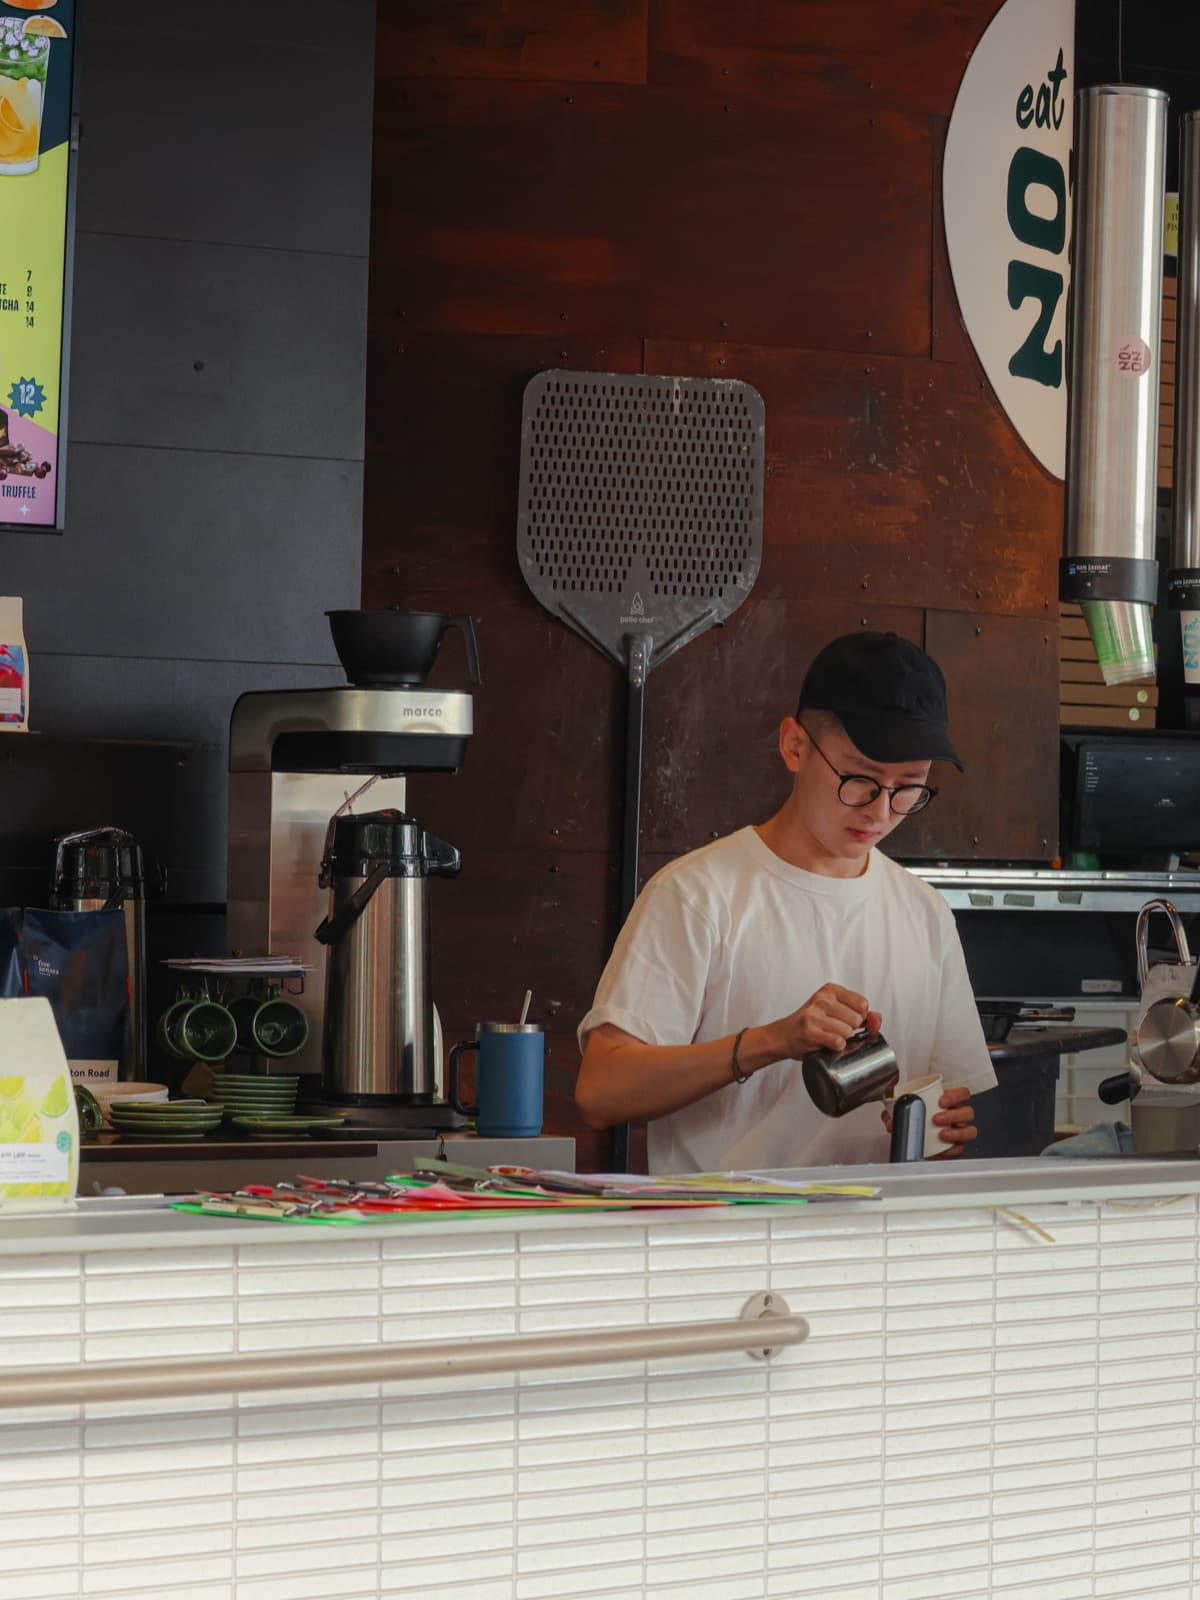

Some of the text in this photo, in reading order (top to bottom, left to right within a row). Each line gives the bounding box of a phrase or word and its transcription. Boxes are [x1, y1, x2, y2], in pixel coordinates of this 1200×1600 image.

[1016, 47, 1067, 130] eat
[27, 270, 32, 281] 7
[26, 301, 34, 312] 14
[20, 384, 35, 404] 12
[2, 484, 36, 498] TRUFFLE
[403, 707, 443, 717] marco
[88, 1068, 110, 1078] Road
